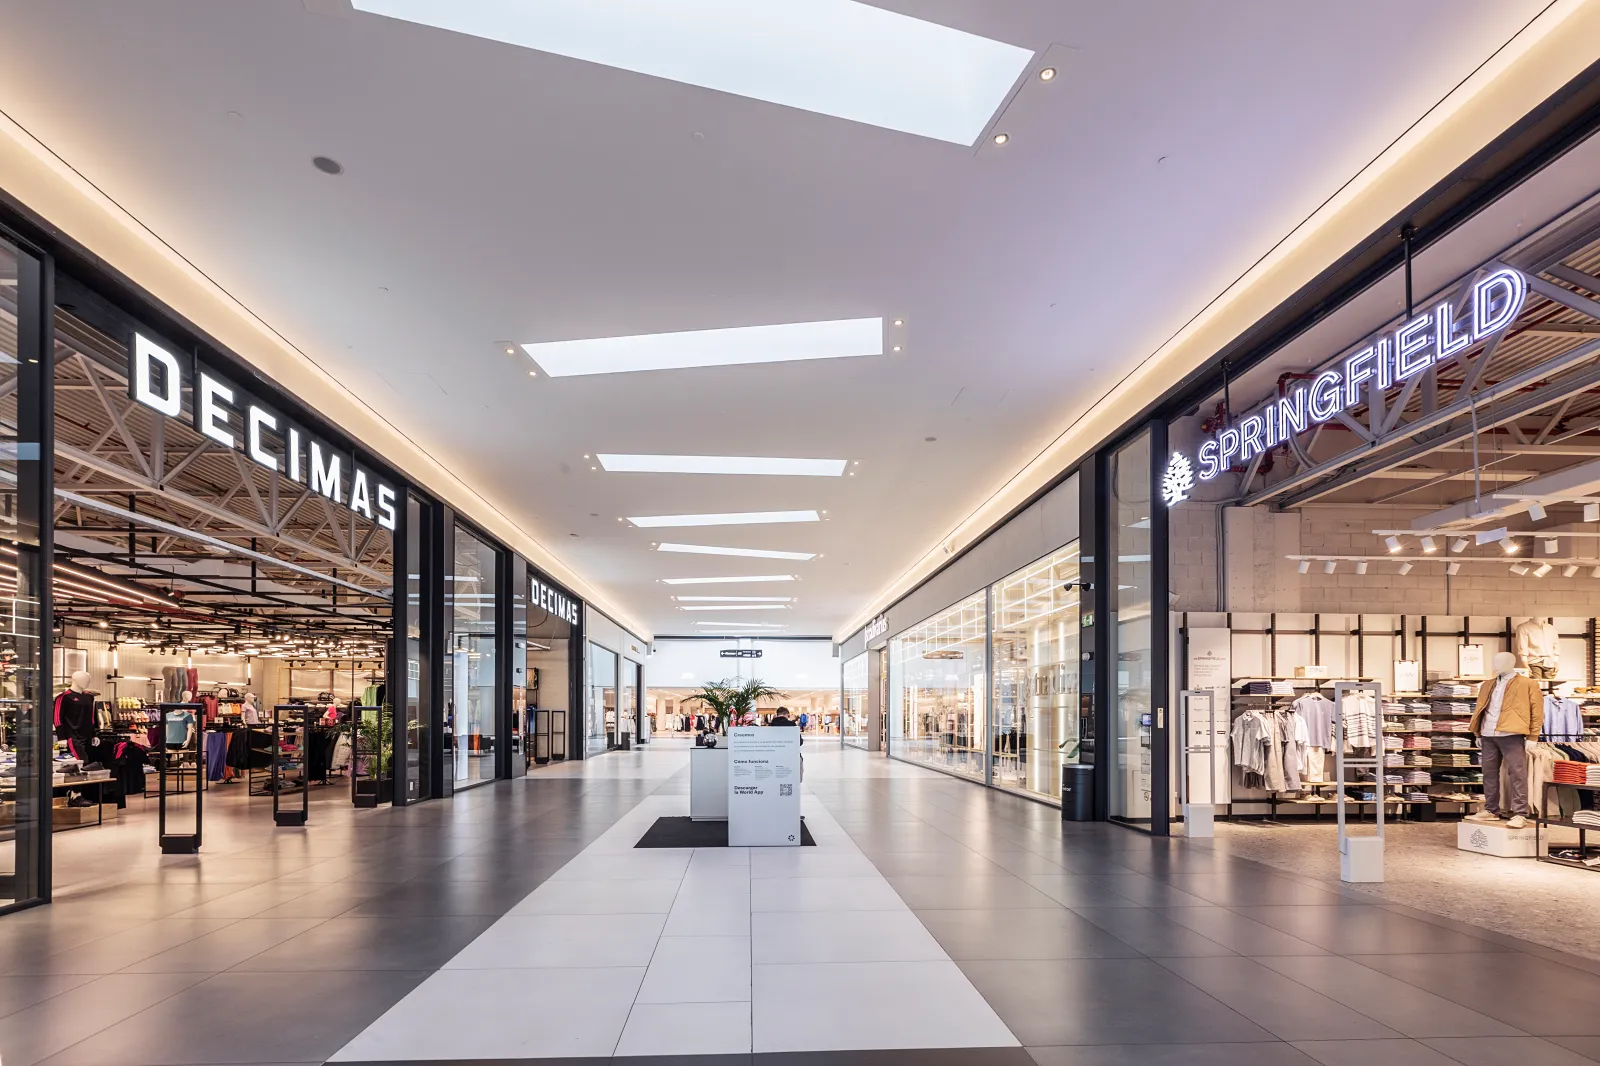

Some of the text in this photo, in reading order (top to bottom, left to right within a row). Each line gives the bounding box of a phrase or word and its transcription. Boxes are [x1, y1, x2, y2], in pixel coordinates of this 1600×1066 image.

[134, 331, 395, 531] DECIMAS
[1199, 268, 1527, 481] SPRINGFIELD
[531, 578, 578, 626] DECIMAS
